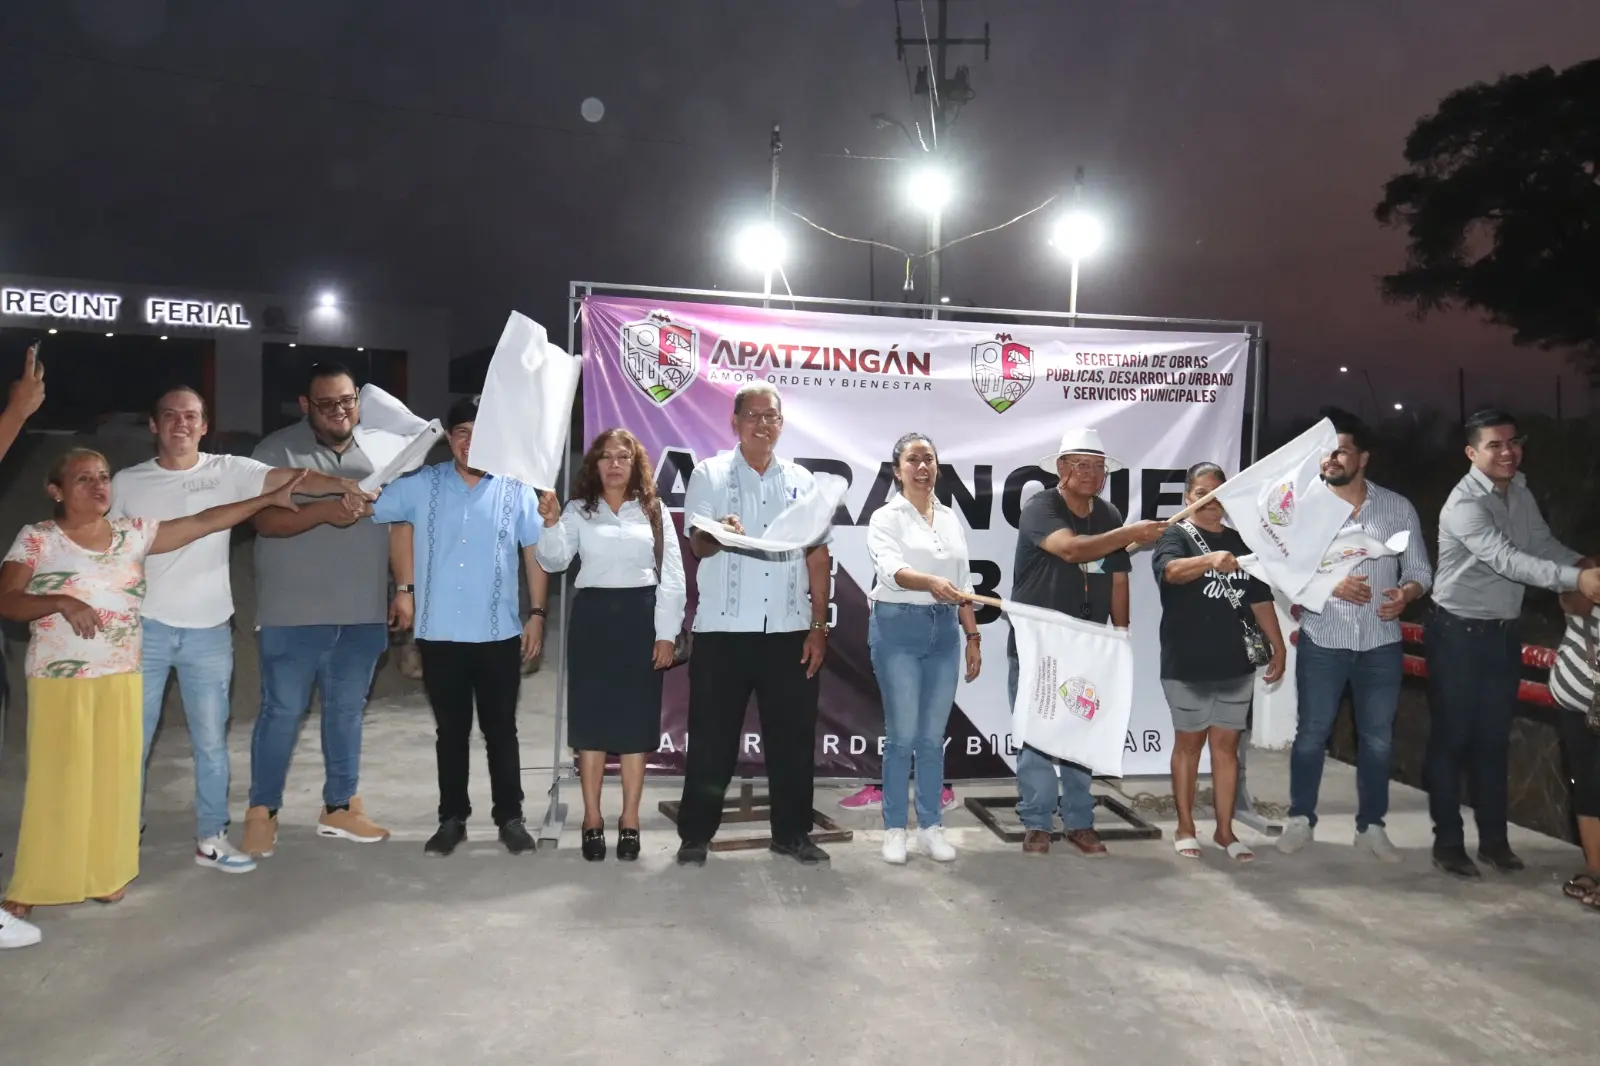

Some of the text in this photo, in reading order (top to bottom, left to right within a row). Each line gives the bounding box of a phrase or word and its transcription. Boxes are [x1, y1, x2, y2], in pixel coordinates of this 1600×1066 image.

[150, 299, 250, 326] FERIAL
[710, 339, 931, 376] APATZINGÁN
[1075, 351, 1209, 369] SECRETARÍA DE OBRAS
[767, 374, 822, 386] ORDEN
[828, 377, 836, 387] Y
[841, 378, 932, 391] BIENESTAR
[1108, 370, 1186, 385] DESARROLLO
[1188, 372, 1234, 386] URBANO
[1063, 385, 1217, 403] Y SERVICIOS MUNICIPALES
